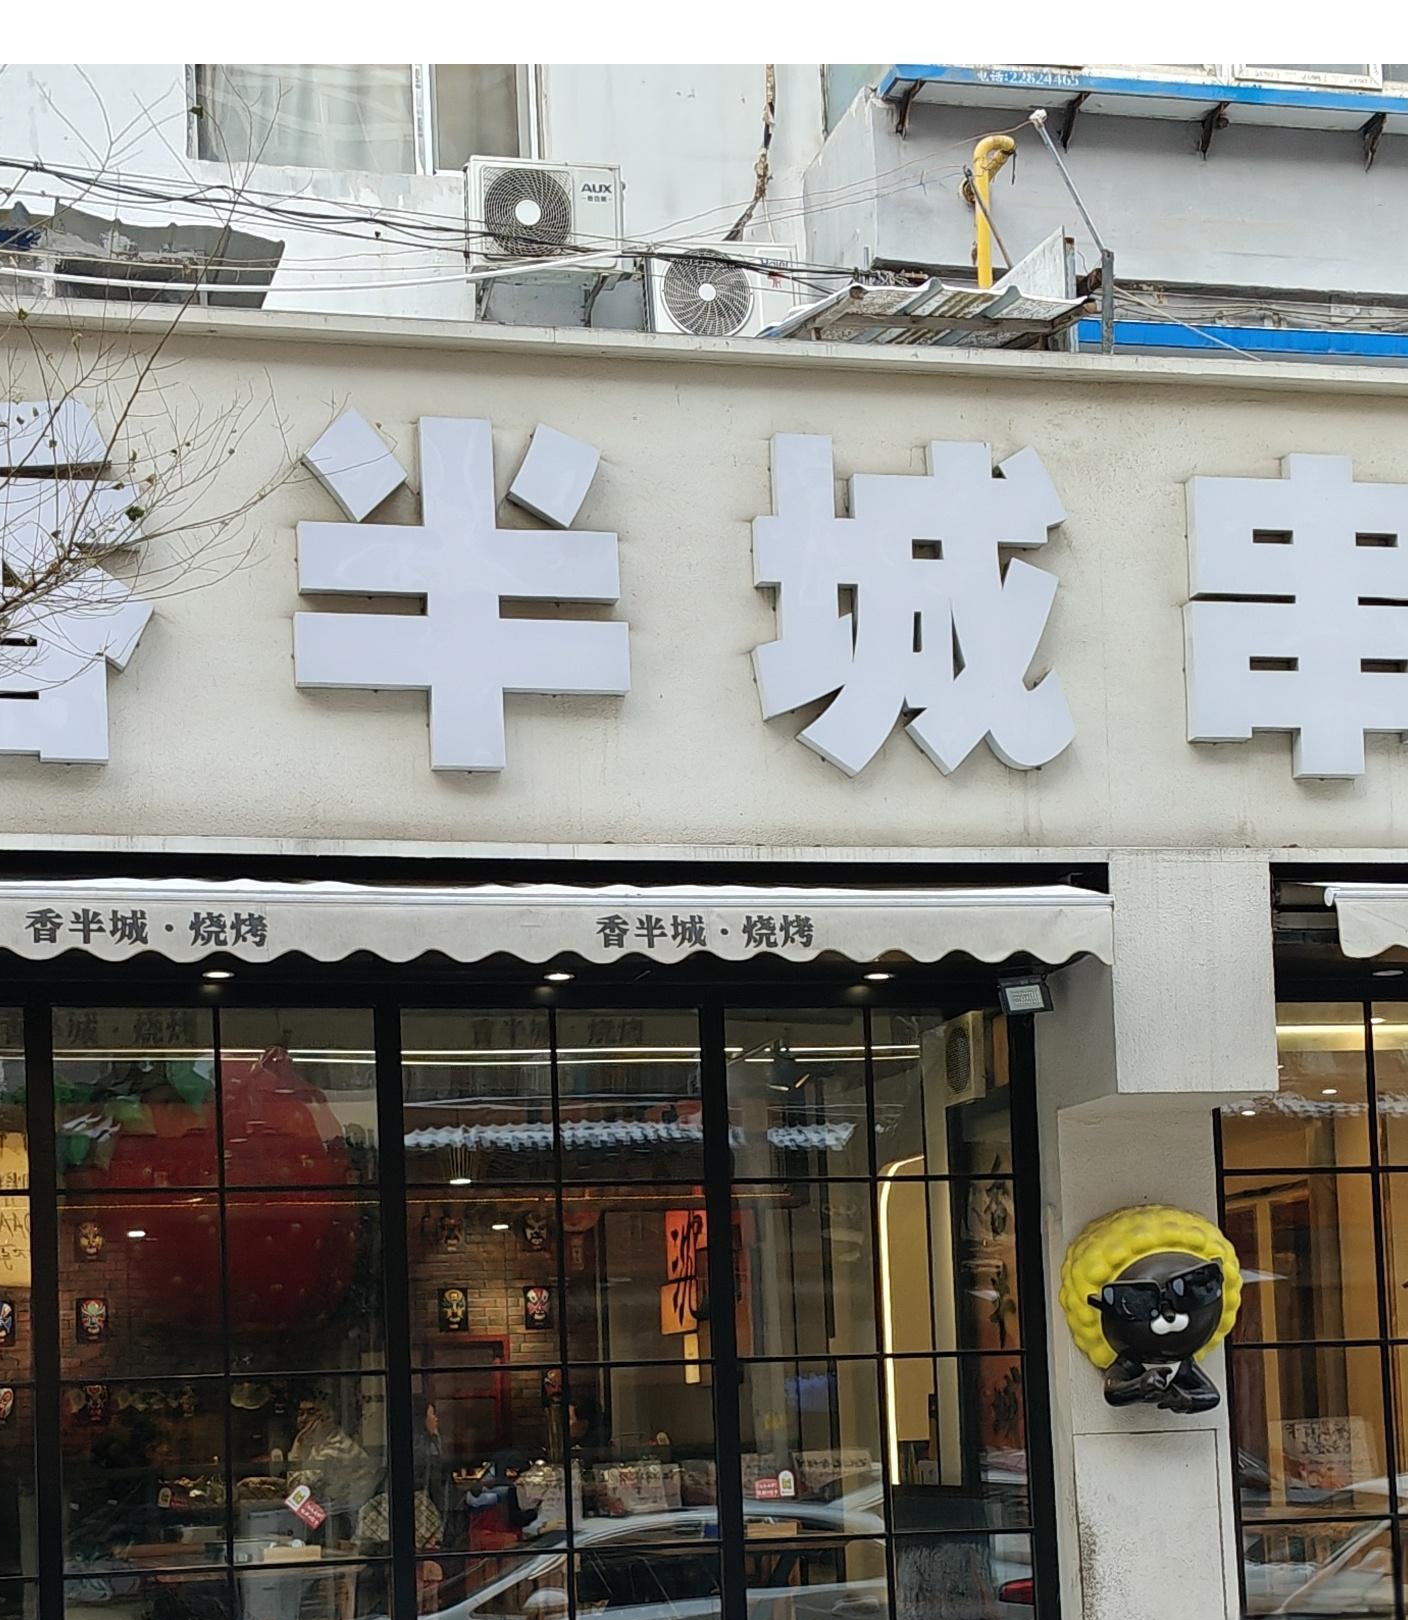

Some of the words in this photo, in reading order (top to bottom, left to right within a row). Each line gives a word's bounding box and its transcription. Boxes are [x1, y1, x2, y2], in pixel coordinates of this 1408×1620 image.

[581, 183, 612, 194] AUX
[24, 908, 268, 948] 香半城·烧烤
[595, 914, 815, 952] 香半城·烧烤
